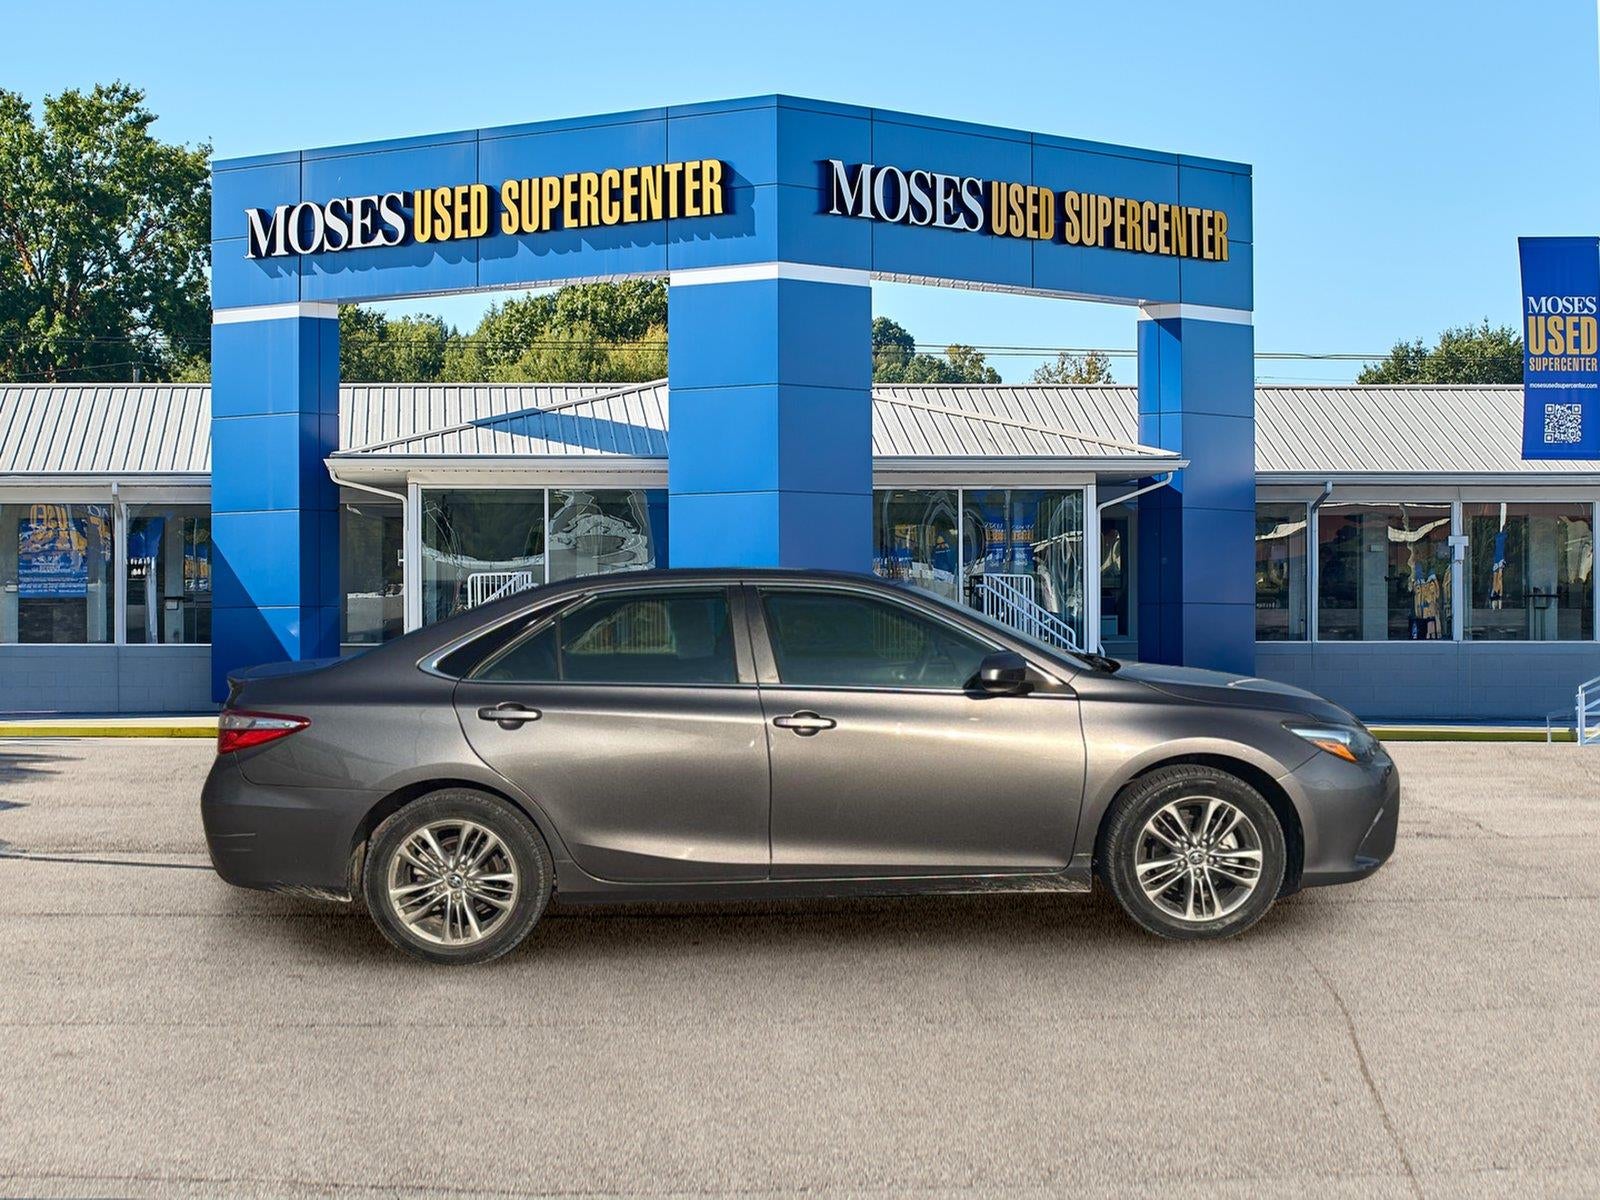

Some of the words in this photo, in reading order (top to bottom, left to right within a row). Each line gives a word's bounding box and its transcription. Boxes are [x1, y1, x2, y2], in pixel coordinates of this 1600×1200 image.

[243, 191, 406, 259] MOSES
[413, 184, 489, 243] USED
[500, 158, 725, 235] SUPERCENTER
[828, 159, 984, 232] MOSES
[991, 181, 1055, 240] USED
[1065, 191, 1229, 261] SUPERCENTER
[1527, 296, 1597, 314] MOSES
[1528, 316, 1597, 355] USED
[1529, 357, 1598, 371] SUPERCENTER
